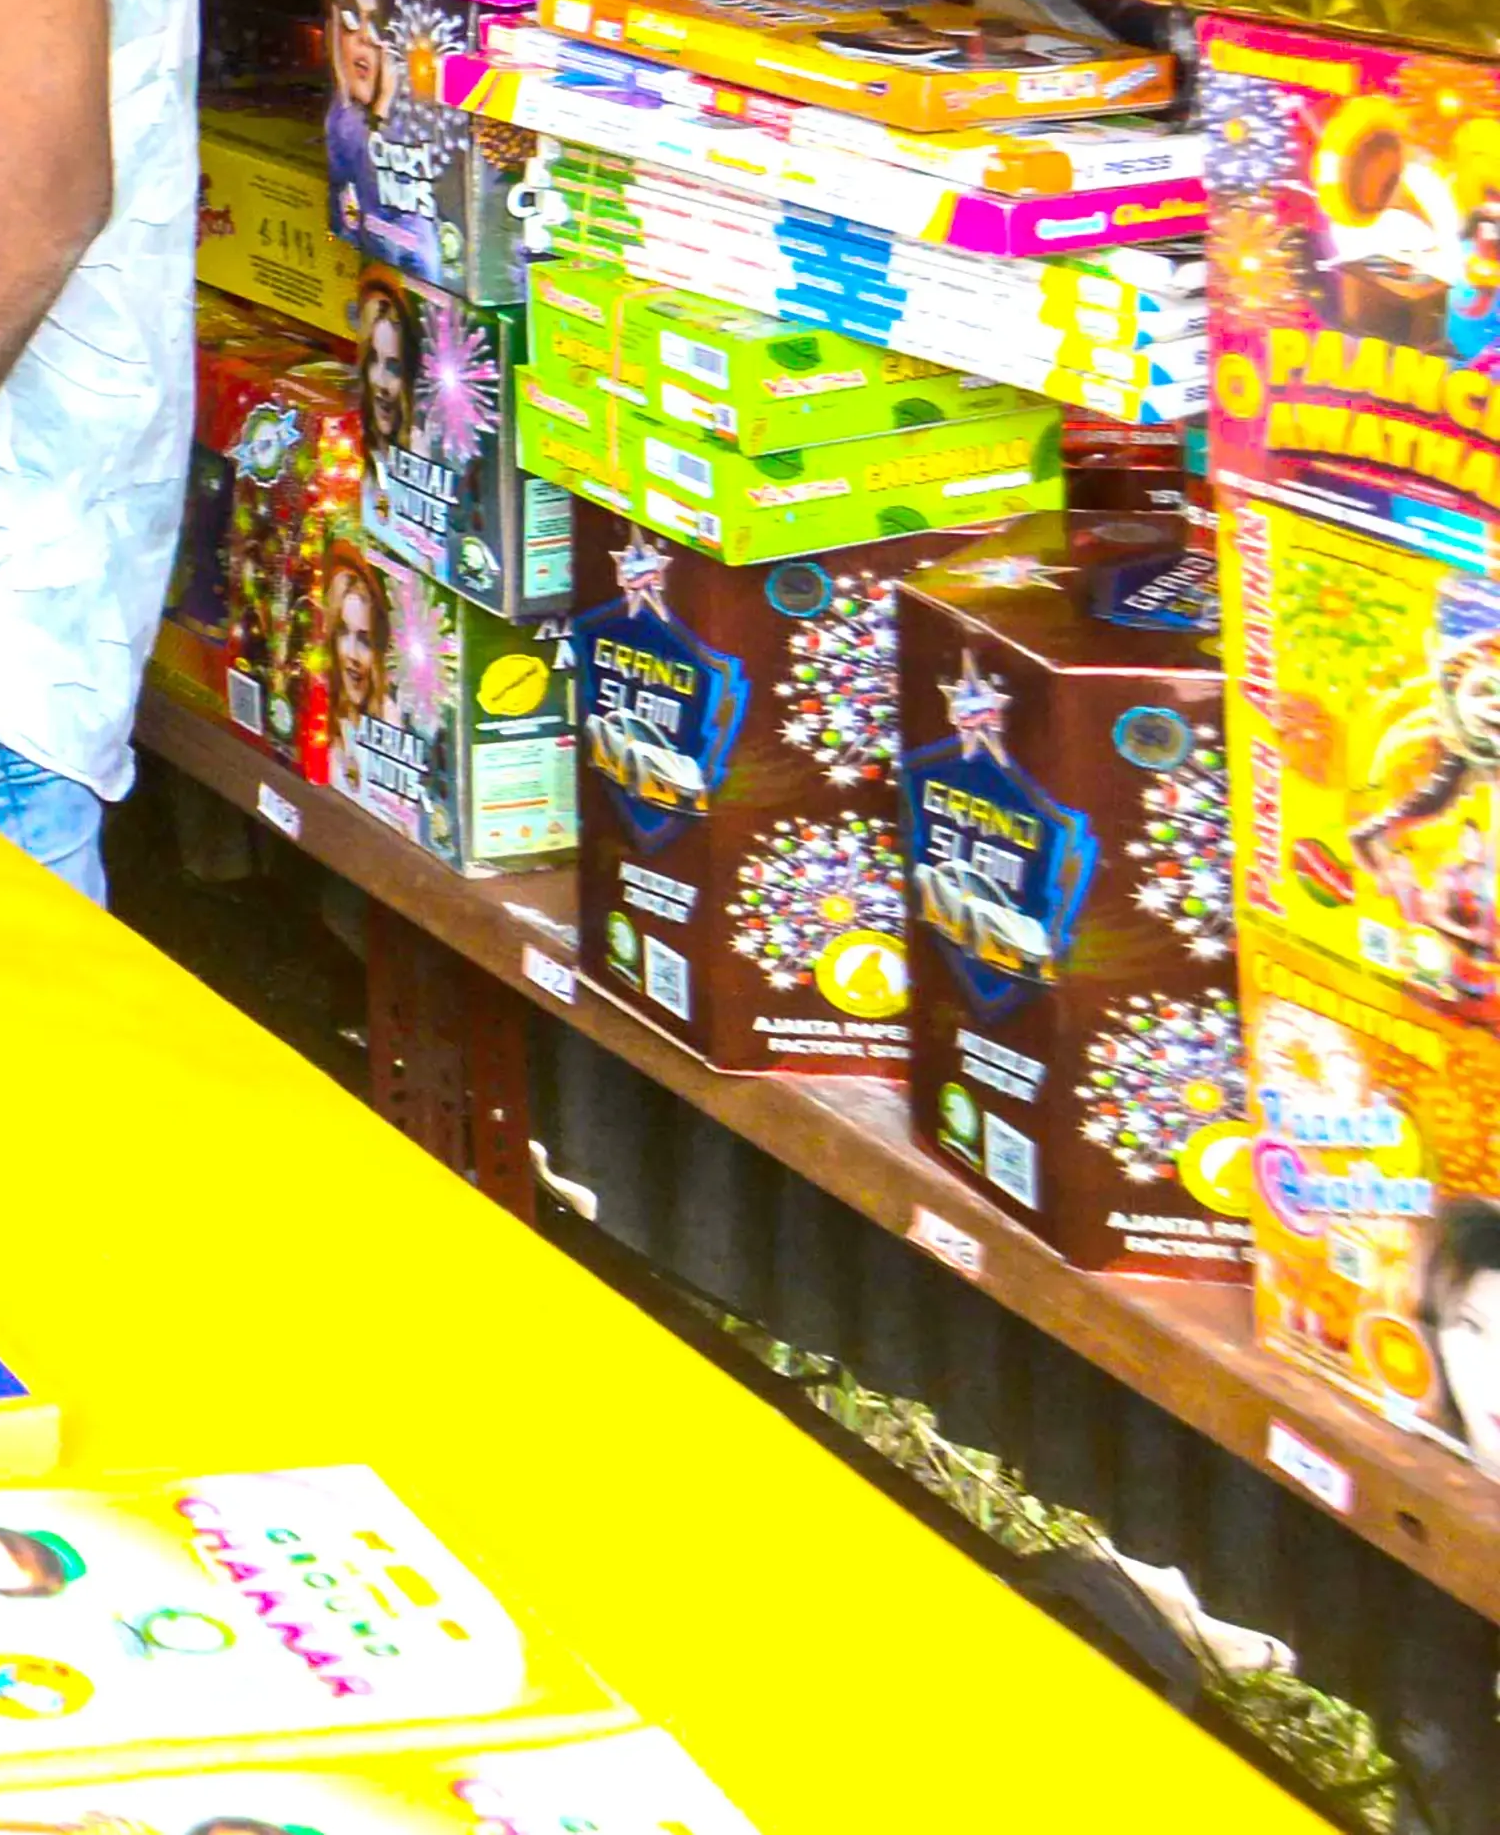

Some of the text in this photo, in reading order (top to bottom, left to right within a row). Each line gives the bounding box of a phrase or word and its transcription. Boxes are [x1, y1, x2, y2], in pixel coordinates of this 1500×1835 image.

[1268, 401, 1500, 507] AWATHA
[1122, 557, 1217, 611] GRAND
[593, 637, 697, 696] GRAND
[922, 778, 1042, 851] GRAND
